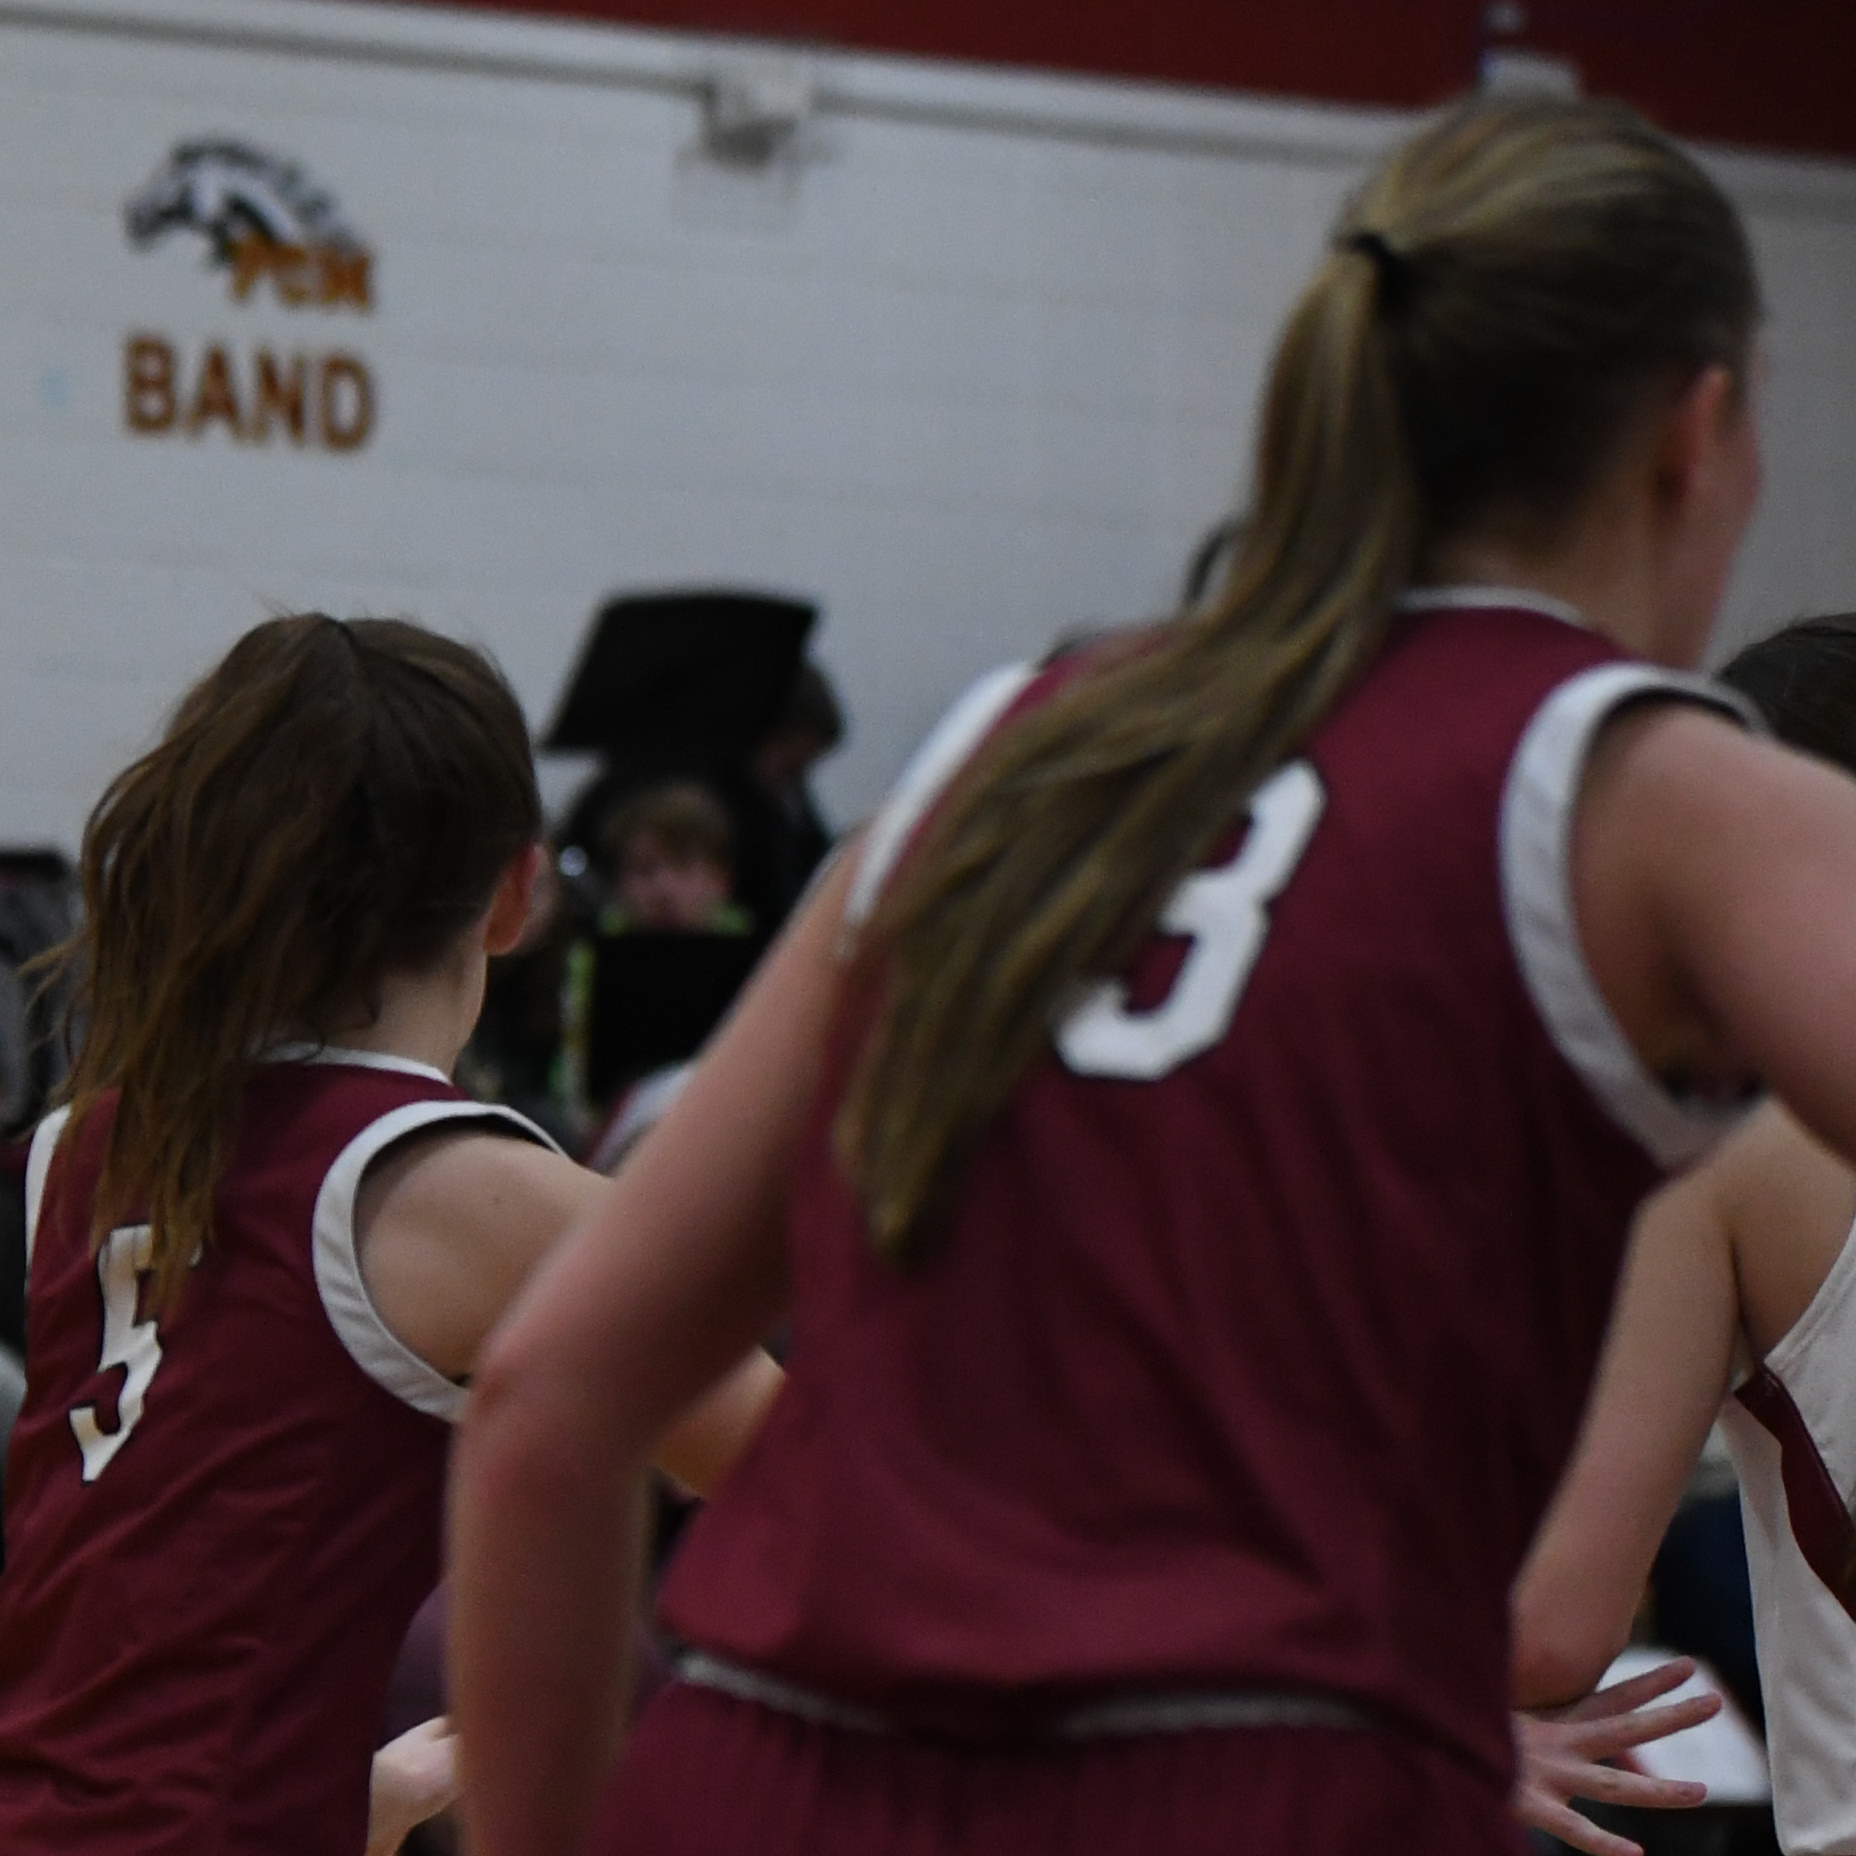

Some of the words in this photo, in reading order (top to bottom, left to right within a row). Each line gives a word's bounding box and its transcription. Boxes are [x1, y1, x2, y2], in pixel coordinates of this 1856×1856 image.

[126, 338, 374, 451] BAND
[1051, 757, 1328, 1085] 3
[68, 1222, 203, 1487] 5
